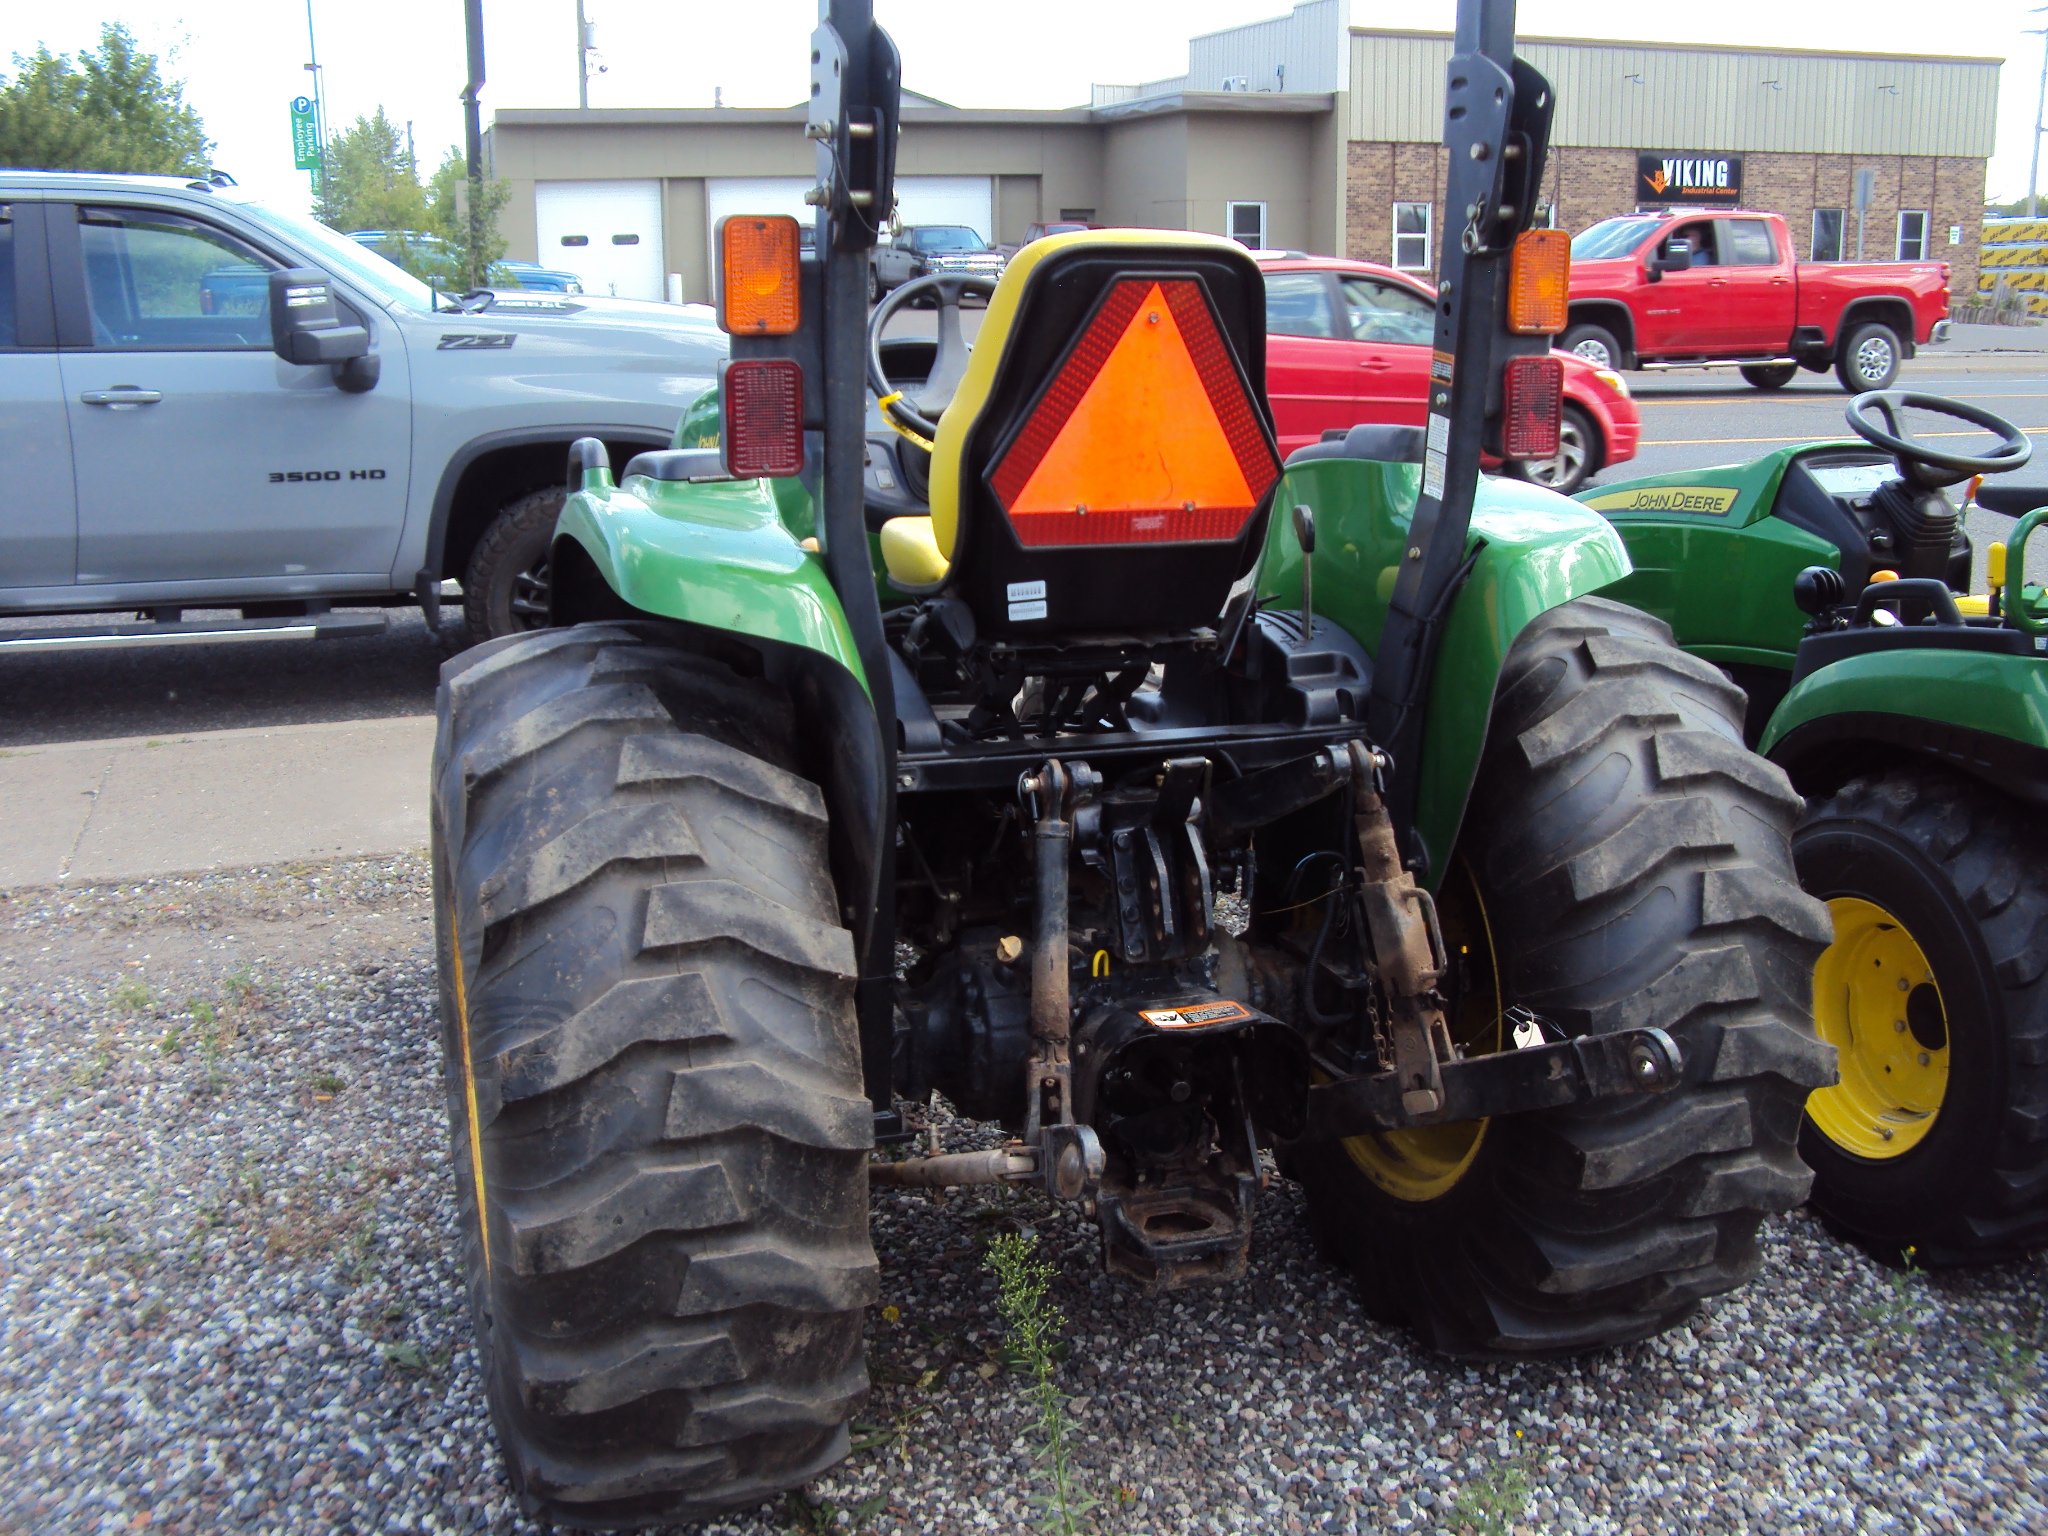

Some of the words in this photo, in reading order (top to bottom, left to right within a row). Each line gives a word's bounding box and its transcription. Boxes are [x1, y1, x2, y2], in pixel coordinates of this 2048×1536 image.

[298, 98, 307, 111] P
[295, 117, 305, 162] Employee
[305, 122, 315, 157] Parking
[1662, 159, 1728, 187] VIKING
[1715, 187, 1738, 195] Center
[268, 471, 341, 483] 3500
[349, 469, 386, 480] HD
[1630, 492, 1671, 508] JOHN
[1671, 492, 1725, 511] DEERE
